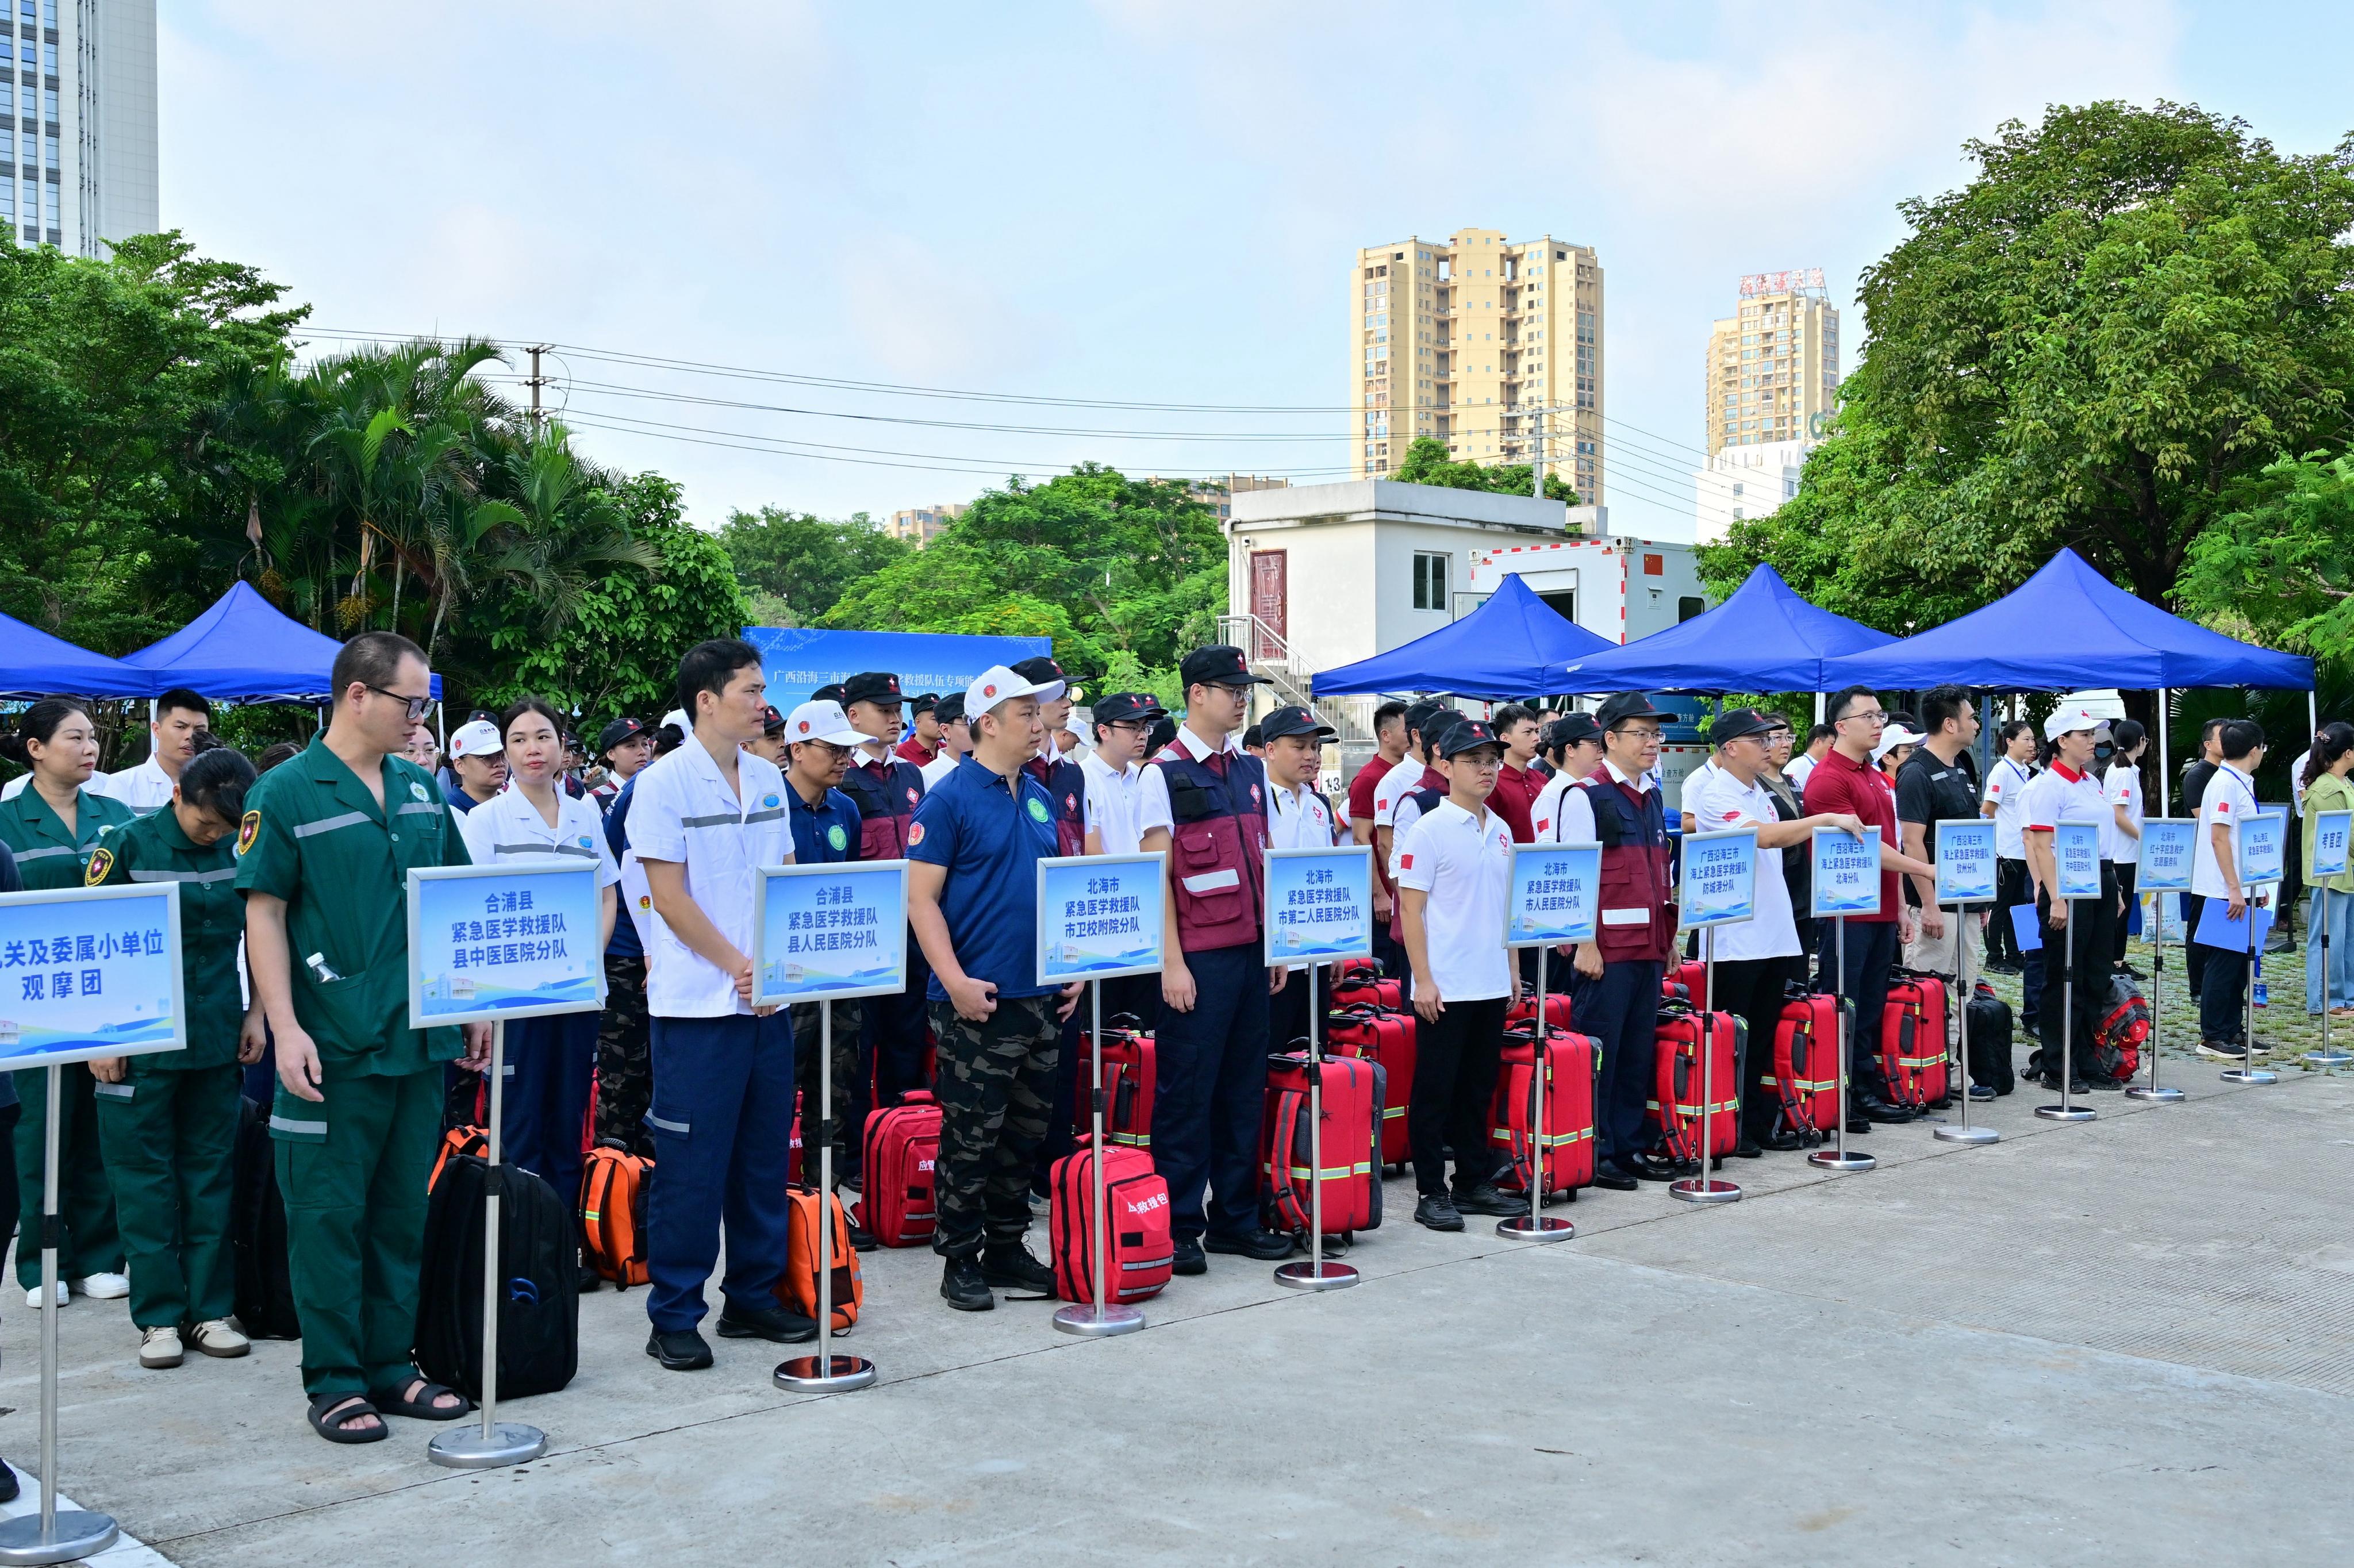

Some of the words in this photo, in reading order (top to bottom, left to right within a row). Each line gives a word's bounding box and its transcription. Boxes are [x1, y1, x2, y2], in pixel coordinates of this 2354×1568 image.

[1952, 835, 1982, 847] 广西沿海三市
[2072, 835, 2083, 845] 北海市
[2160, 832, 2175, 841] 北海市
[2322, 832, 2342, 849] 考官团
[1700, 846, 1739, 863] 广西沿海三市
[1830, 843, 1865, 855] 广西沿海三市
[1944, 848, 1990, 860] 海上紧急医学救援队
[2065, 847, 2091, 859] 紧急医学救援队
[1544, 862, 1568, 876] 北海市
[1690, 860, 1748, 881] 海上紧急医学救援队
[1821, 856, 1873, 870] 海上紧急医学救援队
[1957, 862, 1977, 874] 钦州分队
[1305, 868, 1333, 885] 北海市
[1835, 871, 1859, 885] 北海分队
[1087, 876, 1120, 895] 北海市
[1527, 878, 1581, 894] 紧急医学救援队
[1702, 878, 1734, 896] 防城港分队
[485, 890, 533, 914] 合浦县
[816, 886, 854, 906] 合浦县
[1288, 886, 1351, 905] 紧急医学救援队
[1526, 895, 1580, 912] 市人民医院分队
[1065, 895, 1140, 918] 紧急医学救援队
[788, 906, 878, 931] 紧急医学救援队
[1278, 905, 1360, 926] 市第二人民医院分队
[451, 912, 567, 943] 紧急医学救援队
[1065, 916, 1140, 939] 市卫校附院分队
[0, 928, 164, 969] 关及委属小单位
[787, 929, 877, 954] 县人民医院分队
[452, 937, 568, 969] 县中医医院分队
[21, 968, 102, 1001] 观摩团
